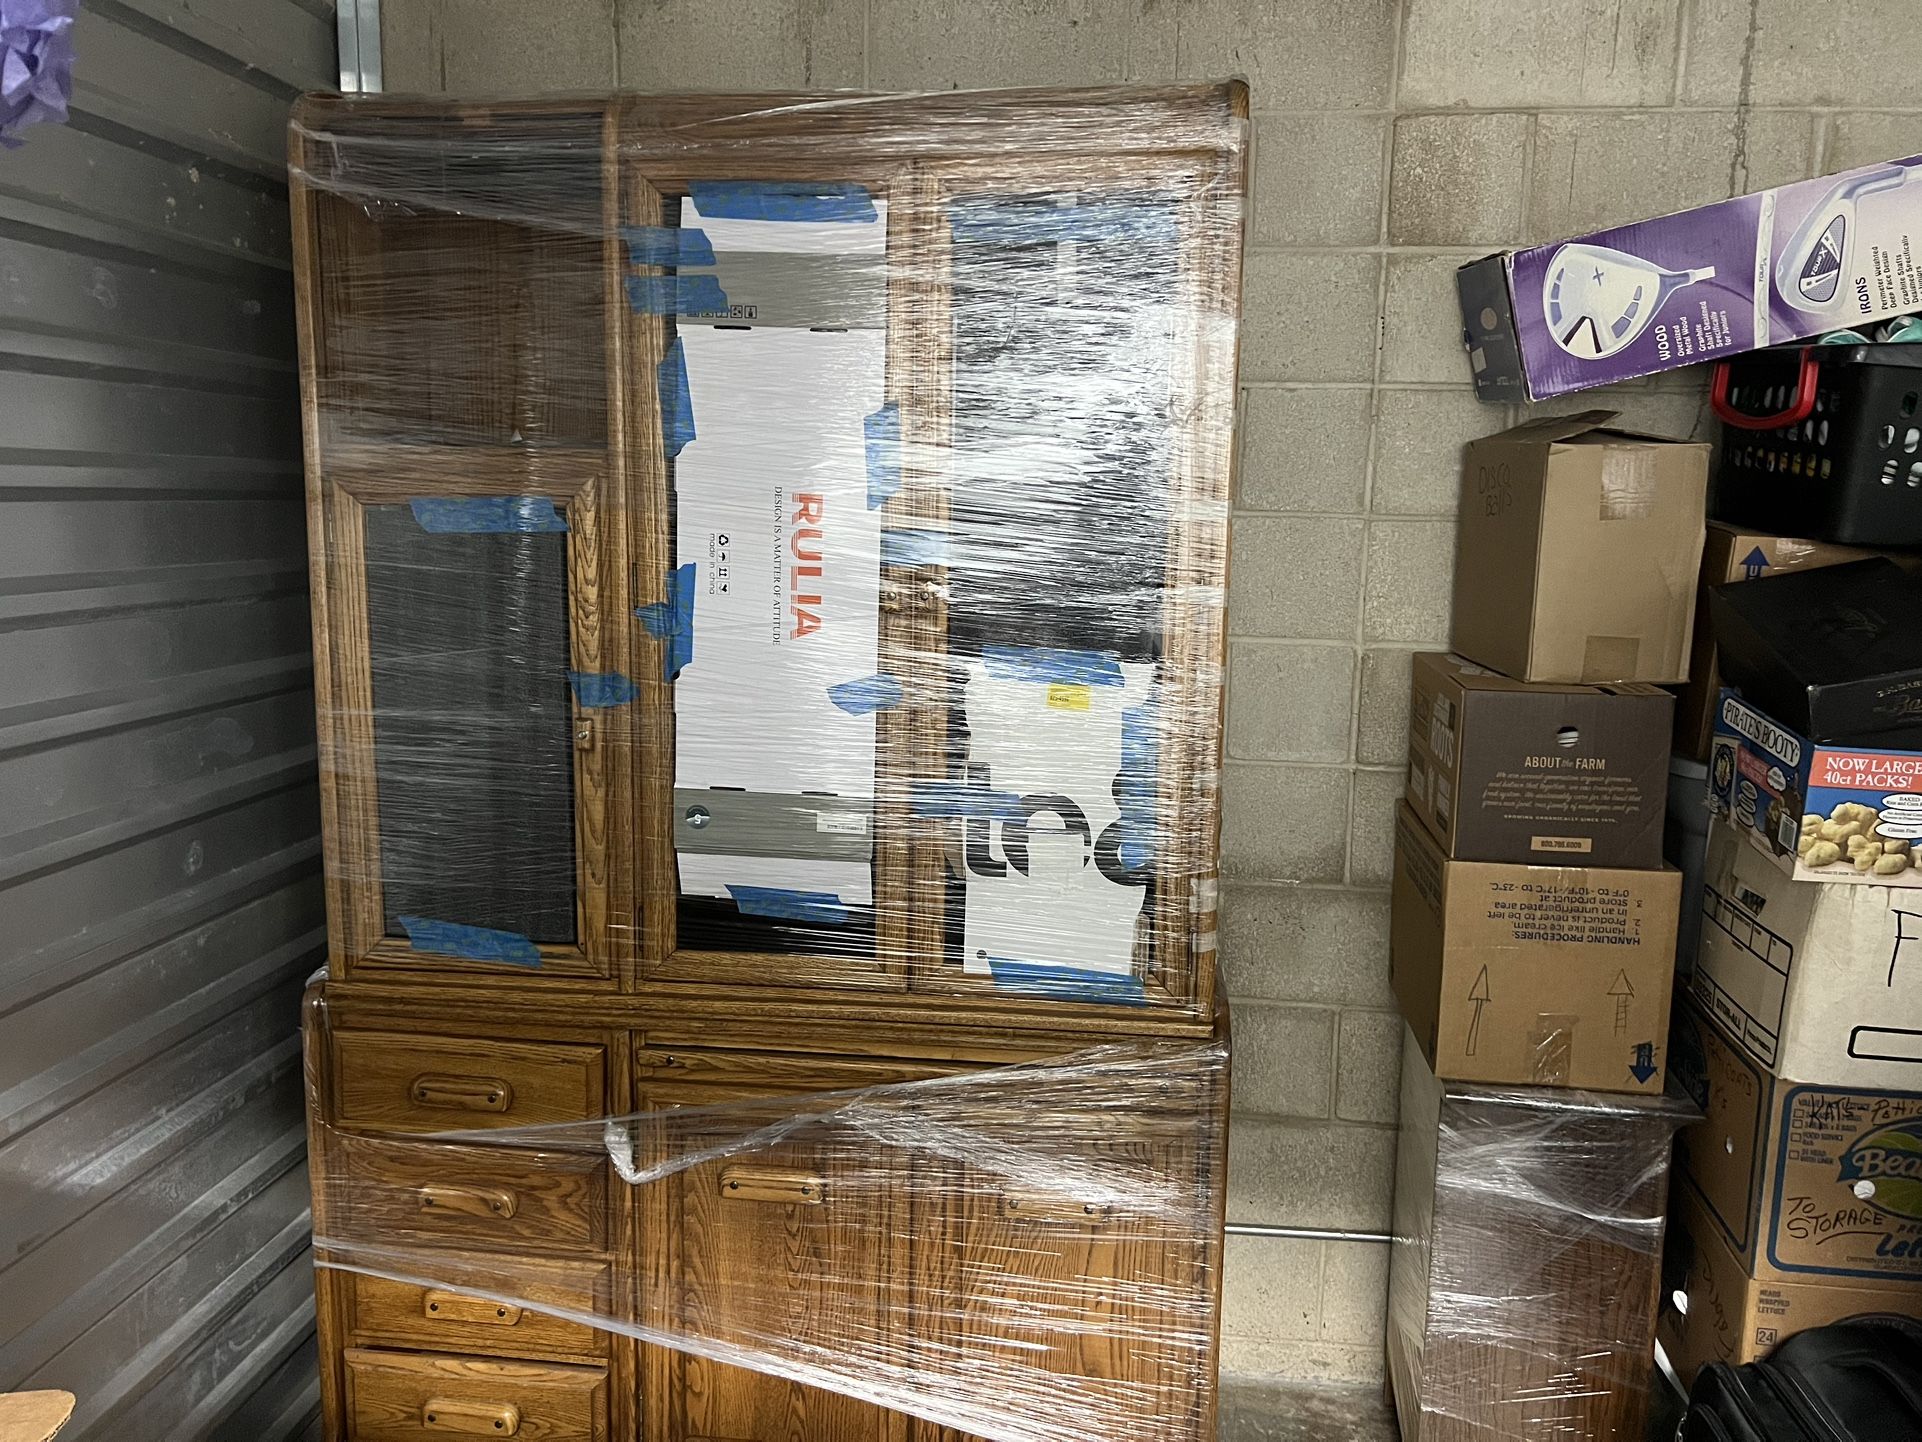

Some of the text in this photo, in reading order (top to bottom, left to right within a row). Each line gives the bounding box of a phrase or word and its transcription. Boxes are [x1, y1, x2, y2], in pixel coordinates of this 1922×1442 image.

[1882, 251, 1890, 273] Design
[1872, 246, 1888, 310] Perimeter Weighted
[1856, 277, 1872, 314] IRONS
[1900, 277, 1910, 305] Graphite
[1907, 274, 1919, 303] Designed
[1889, 292, 1897, 308] Deep
[1699, 301, 1715, 350] Shaft Designed
[1710, 311, 1723, 348] Specifically
[1655, 325, 1671, 360] WOOD
[1672, 325, 1685, 357] Oversized
[1680, 316, 1694, 355] Metal Wood
[1695, 323, 1706, 352] Graphite
[774, 486, 782, 522] DESIGN
[774, 525, 782, 534] IS
[773, 544, 782, 583] MATTER
[790, 492, 824, 641] RULIA
[773, 585, 781, 596] OF
[772, 600, 781, 646] ATTITUDE
[1725, 702, 1797, 763] PIRATE'S BOOTY
[1524, 756, 1561, 769] ABOUT
[1575, 758, 1606, 770] FARM
[1826, 757, 1870, 771] NOW
[1824, 771, 1912, 788] 40ct PACKS!
[1522, 884, 1533, 893] to
[1597, 889, 1609, 897] to
[1540, 895, 1551, 903] at
[1553, 895, 1596, 905] product
[1600, 898, 1628, 907] Store
[1487, 910, 1505, 920] left
[1520, 902, 1599, 914] unrefrigerated
[1601, 907, 1615, 915] an
[1508, 912, 1521, 921] be
[1524, 913, 1536, 922] to
[1539, 914, 1569, 922] never
[1583, 916, 1626, 926] Product
[1568, 925, 1585, 934] like
[1589, 926, 1626, 935] Handle
[1512, 930, 1640, 946] HANDLING PROCEDURES:
[1787, 1197, 1816, 1216] TO
[1787, 1208, 1887, 1239] STORAGE
[1758, 1331, 1774, 1344] 24
